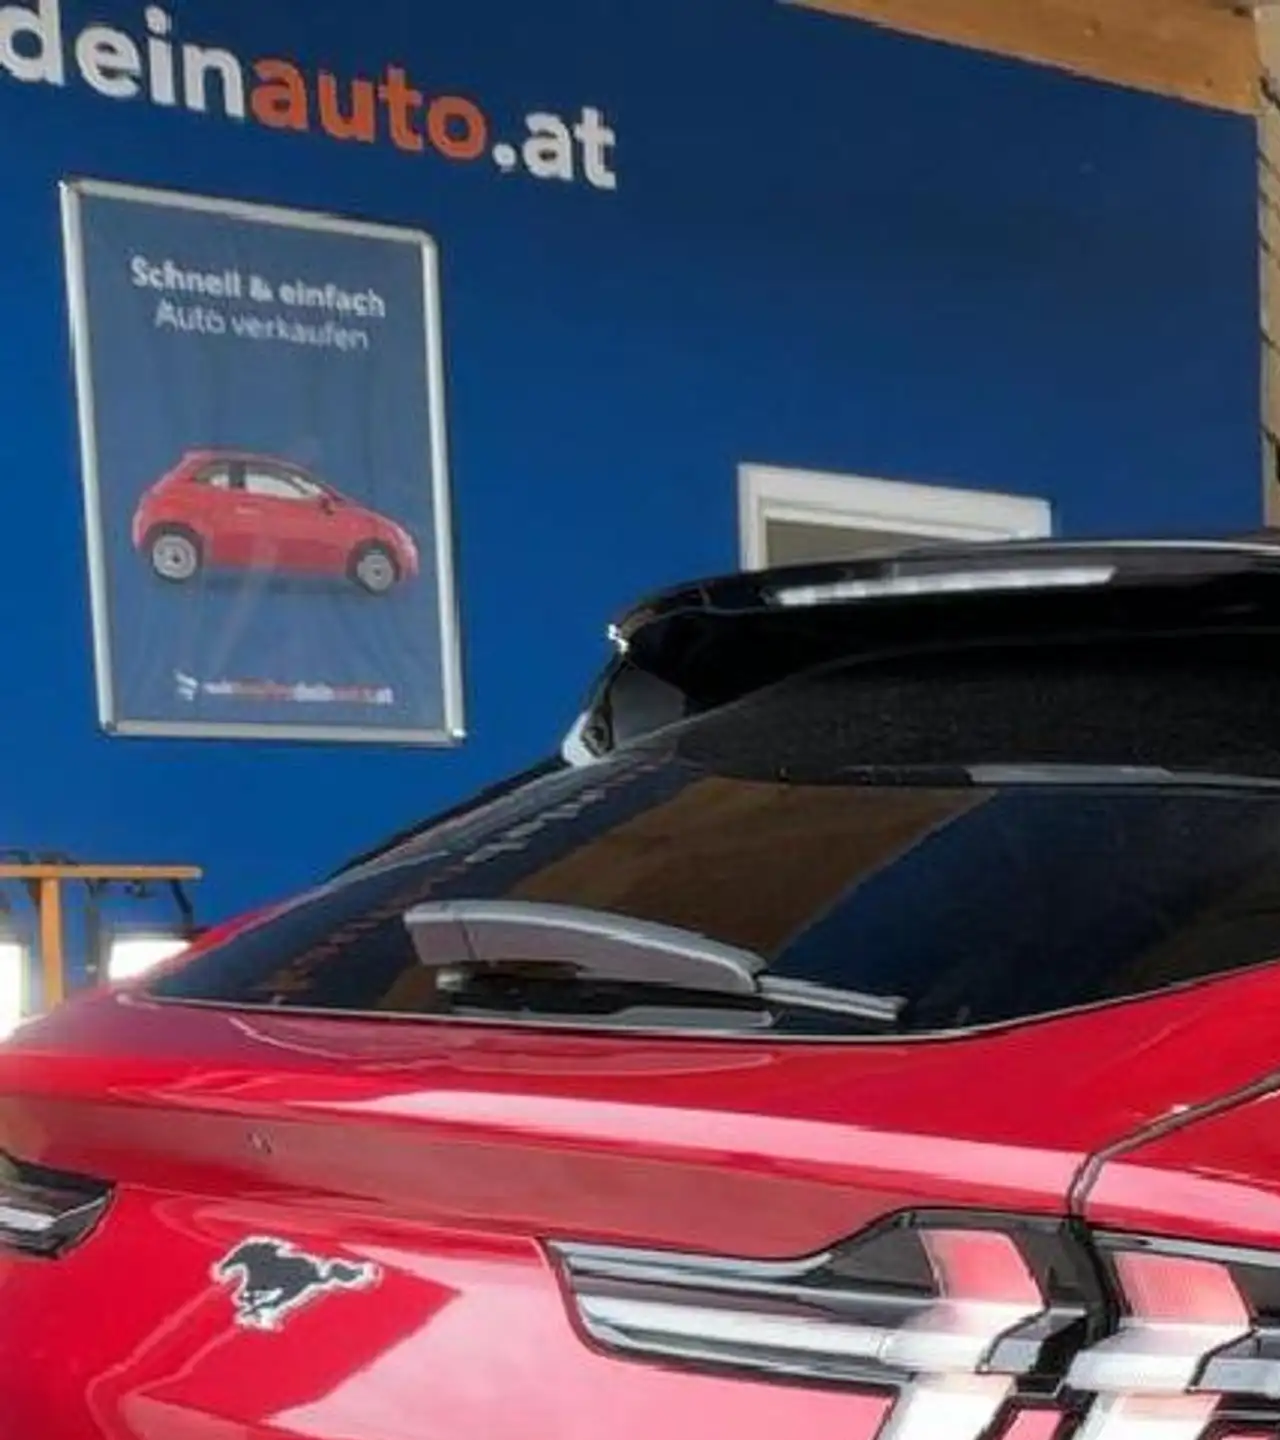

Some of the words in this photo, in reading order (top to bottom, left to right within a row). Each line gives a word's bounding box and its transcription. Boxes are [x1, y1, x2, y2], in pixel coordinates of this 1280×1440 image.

[0, 0, 617, 191] deinauto.at
[131, 254, 241, 298] Schnell
[249, 273, 274, 302] &
[278, 278, 386, 319] einfach
[154, 296, 227, 335] Auto
[230, 312, 370, 351] verkaufen
